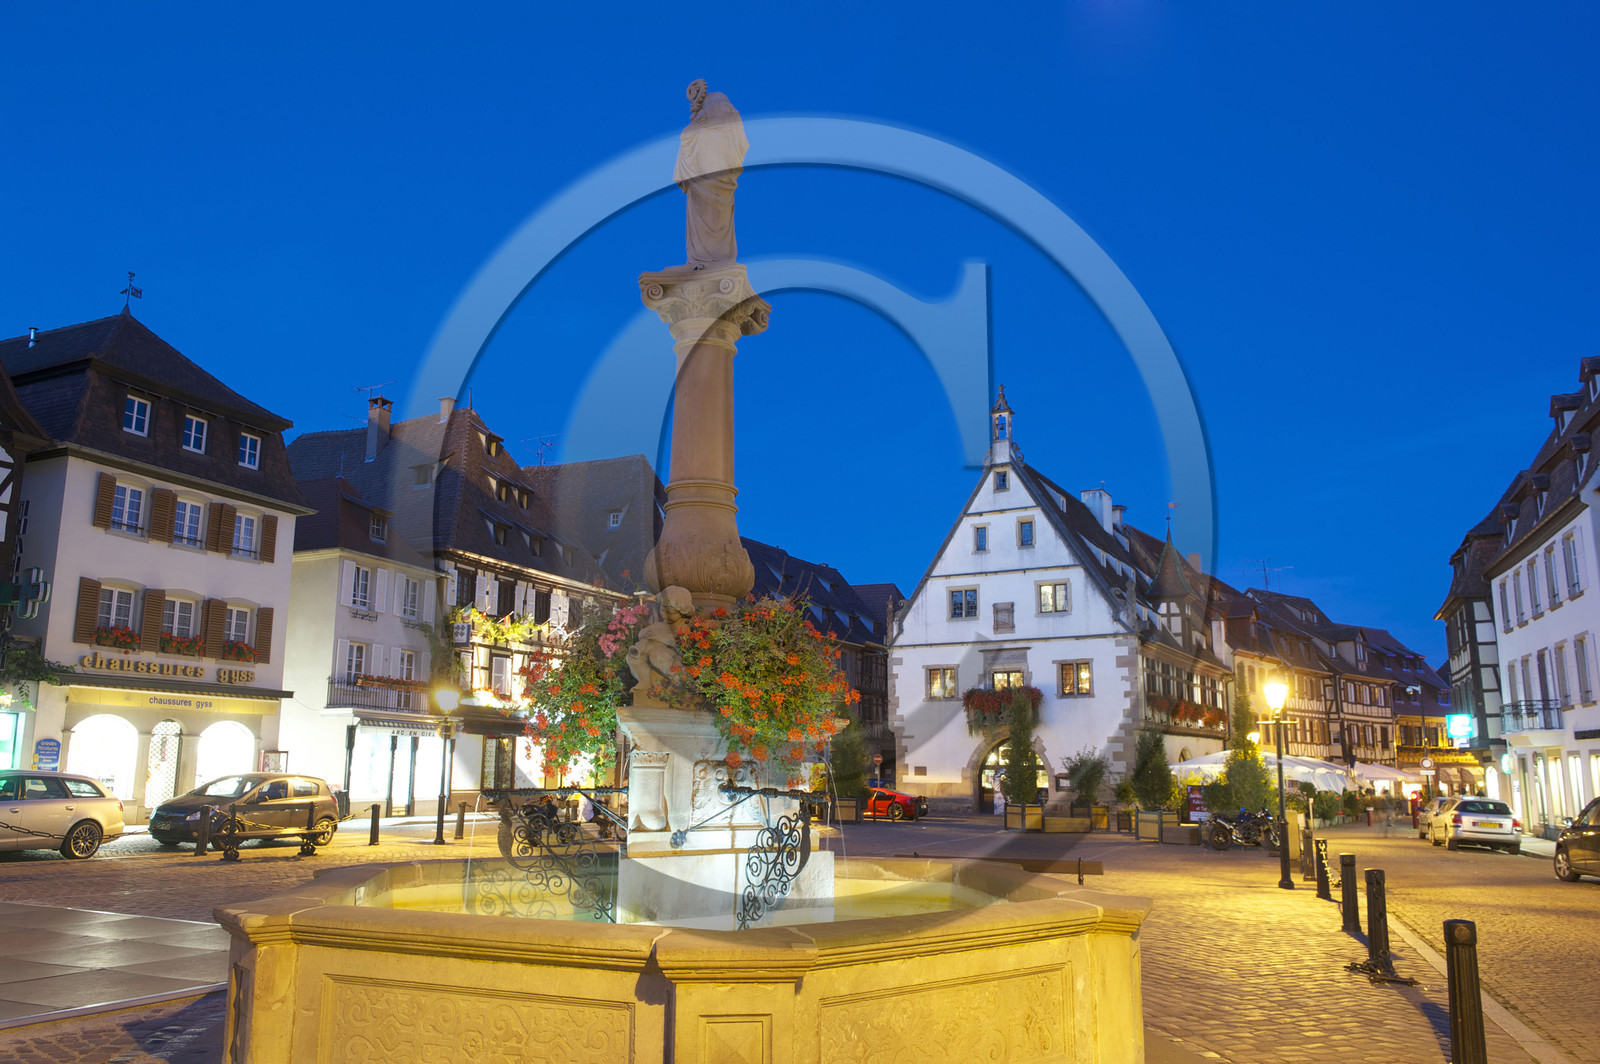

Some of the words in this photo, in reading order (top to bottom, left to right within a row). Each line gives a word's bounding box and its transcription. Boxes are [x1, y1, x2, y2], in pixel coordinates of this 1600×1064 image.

[82, 651, 206, 677] chaussures
[217, 667, 256, 684] gyss
[148, 696, 192, 707] chaussures
[195, 700, 213, 709] gyss
